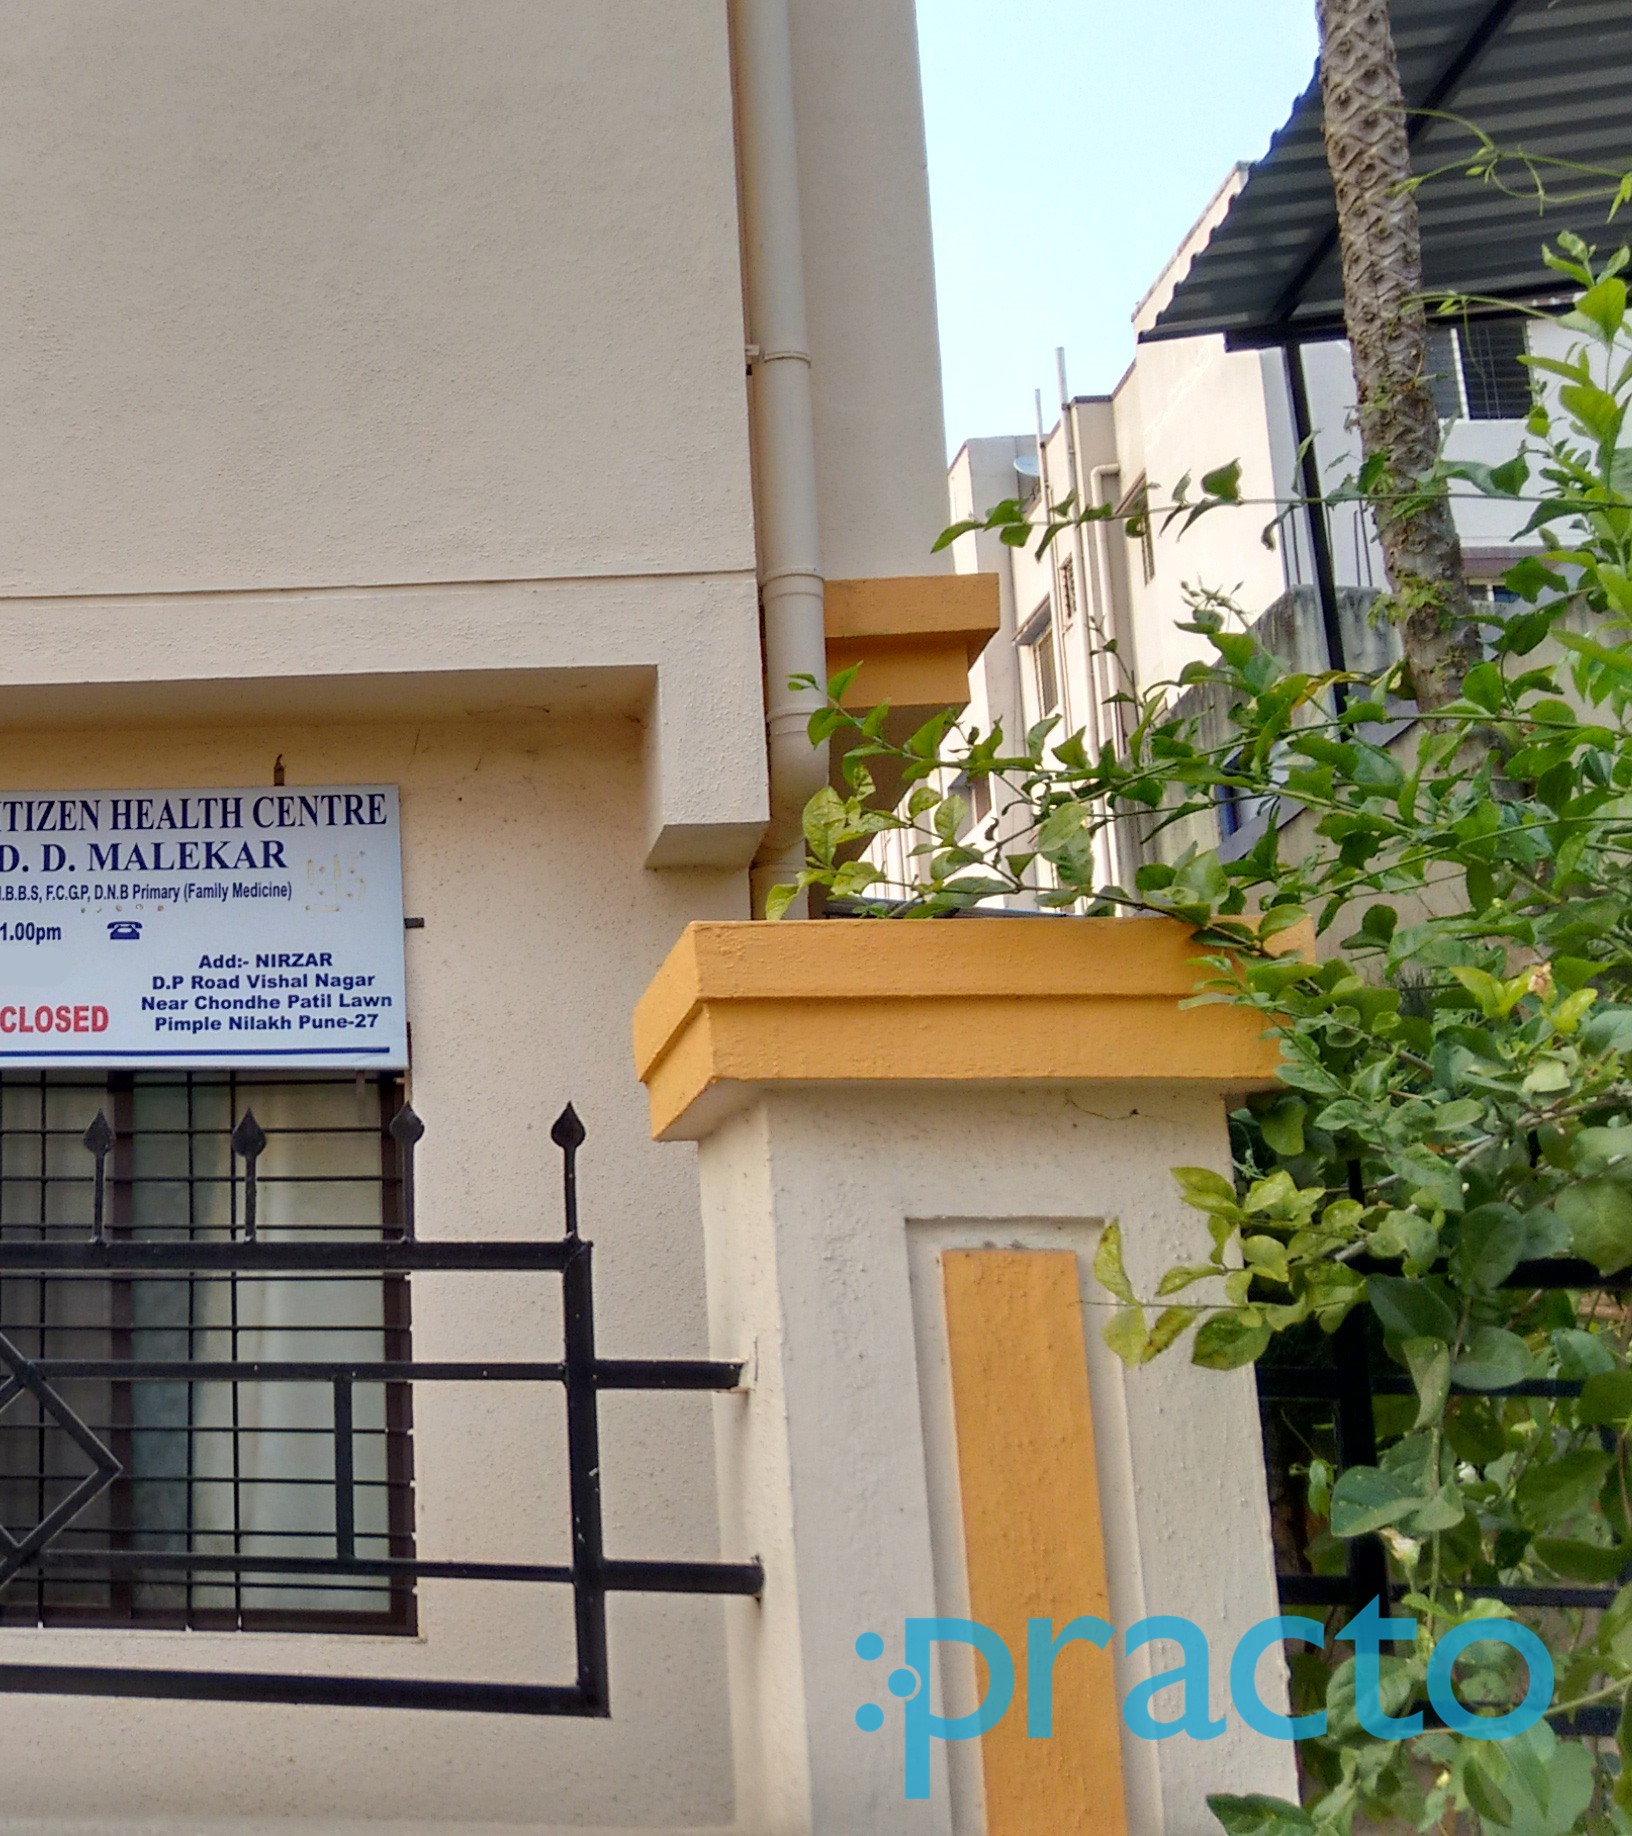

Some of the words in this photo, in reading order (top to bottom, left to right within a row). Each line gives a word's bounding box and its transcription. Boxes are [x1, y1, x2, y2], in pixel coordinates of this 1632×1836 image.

[111, 796, 243, 831] HEALTH
[252, 793, 388, 828] CENTRE
[40, 842, 75, 872] D.
[87, 839, 288, 872] MALEKAR
[94, 884, 129, 900] D.N.B
[133, 883, 179, 903] Primary
[183, 882, 229, 902] (Family
[232, 881, 293, 901] Medicine)
[0, 921, 61, 945] 1.00pm
[198, 954, 249, 969] Add:-
[256, 952, 333, 968] NIRZAR
[152, 975, 184, 990] D.P
[191, 974, 240, 990] Road
[246, 973, 308, 989] Vishal
[316, 973, 375, 991] Nagar
[141, 996, 188, 1011] Near
[194, 994, 280, 1010] Chondhe
[288, 993, 332, 1009] Patil
[339, 993, 392, 1008] Lawn
[0, 1005, 109, 1034] CLOSED
[155, 1016, 221, 1034] Pimple
[229, 1015, 292, 1031] Nilakh
[299, 1013, 379, 1030] Pune-27
